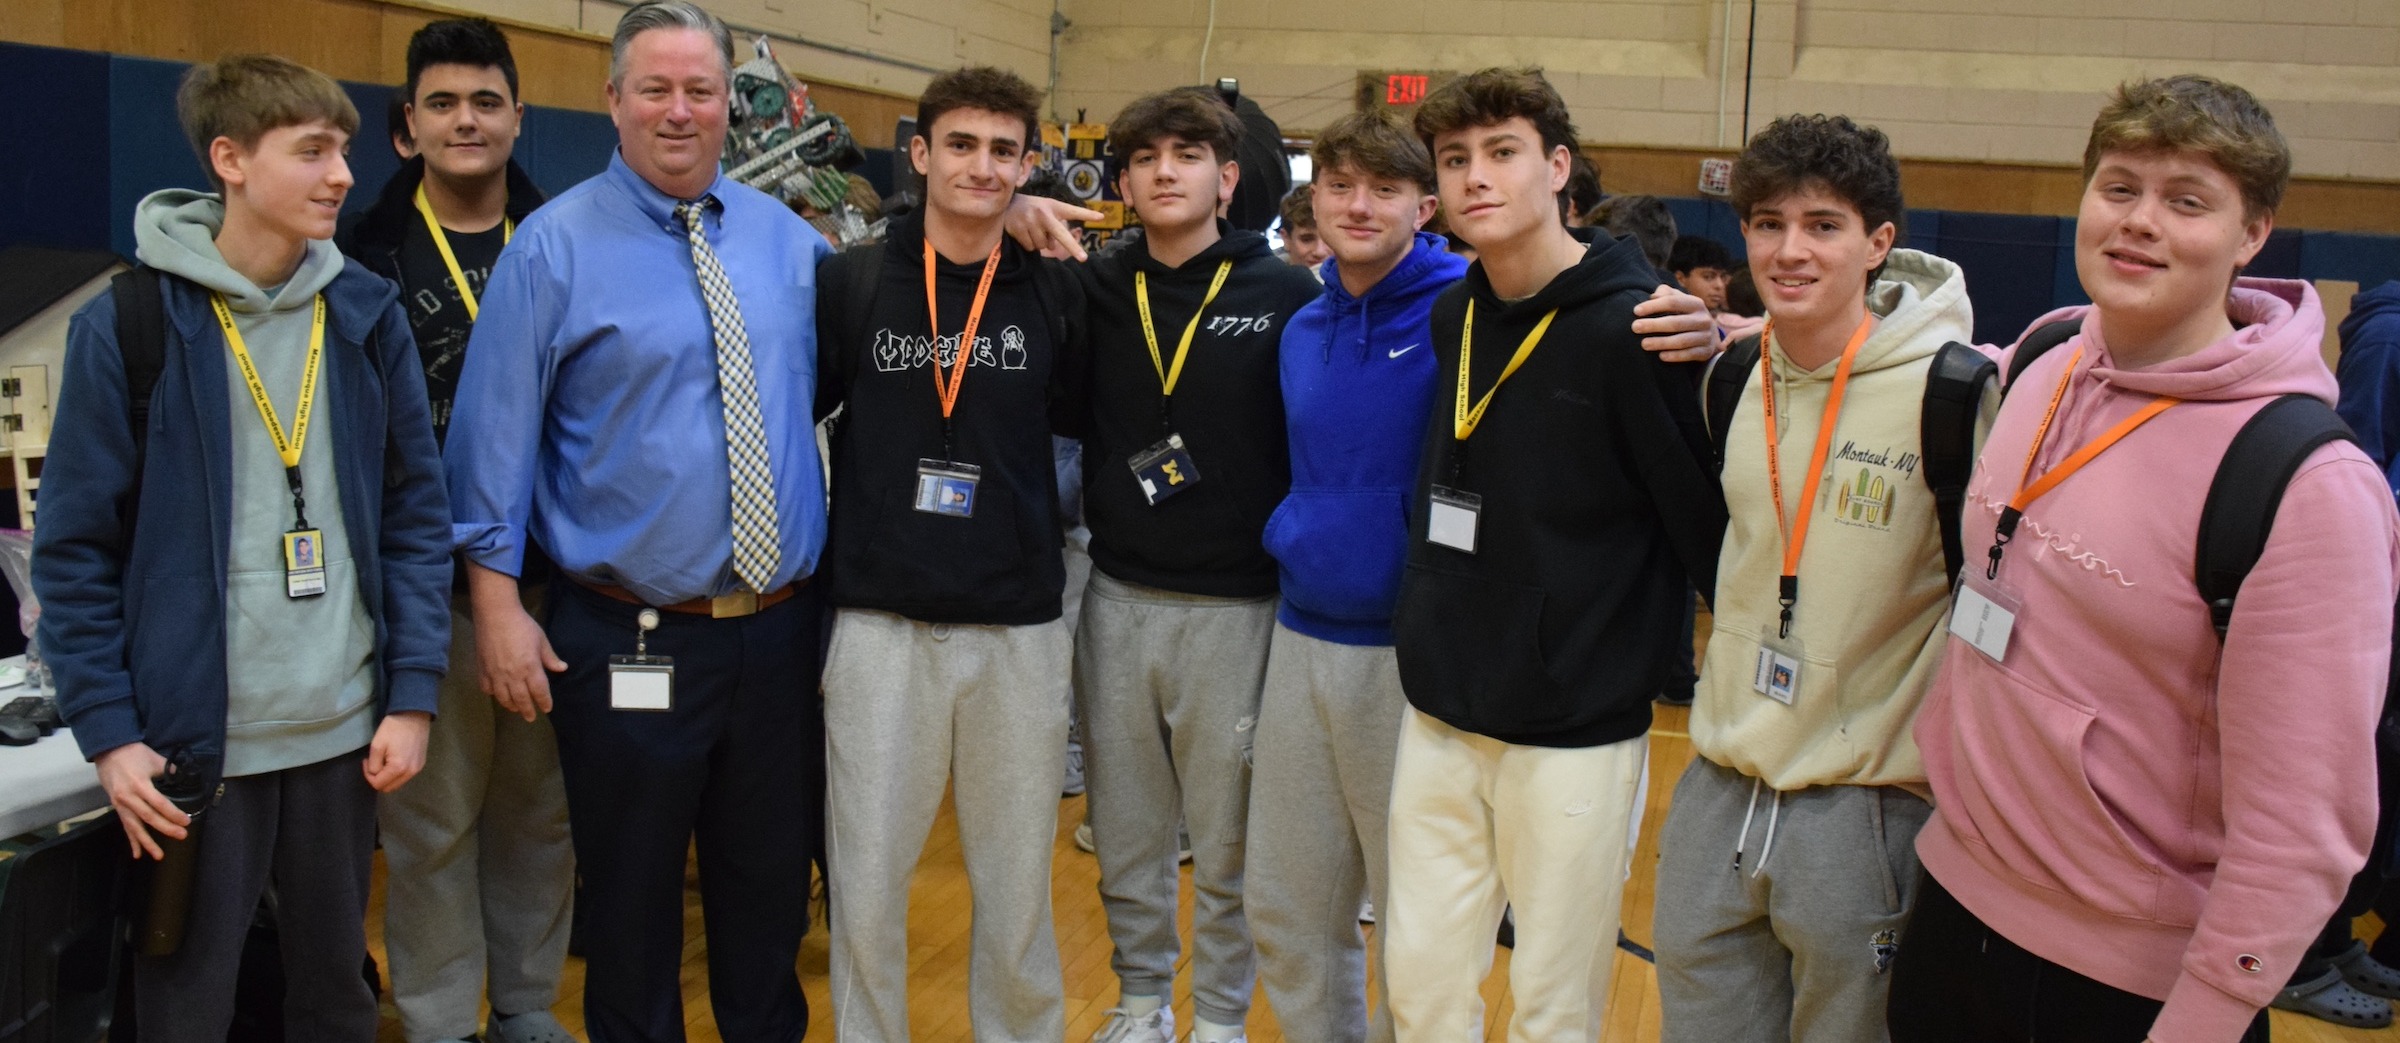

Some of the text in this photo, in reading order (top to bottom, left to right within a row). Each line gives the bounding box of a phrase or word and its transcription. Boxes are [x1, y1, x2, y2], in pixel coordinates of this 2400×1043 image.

[1387, 75, 1428, 104] EXIT
[1206, 311, 1276, 337] 1776
[1461, 323, 1470, 372] Massapequa
[238, 353, 288, 452] Massapequa High School
[294, 348, 319, 450] Massapequa High School
[1764, 361, 1772, 417] Massapequa
[1769, 444, 1777, 475] School
[1836, 440, 1920, 480] Montauk NY
